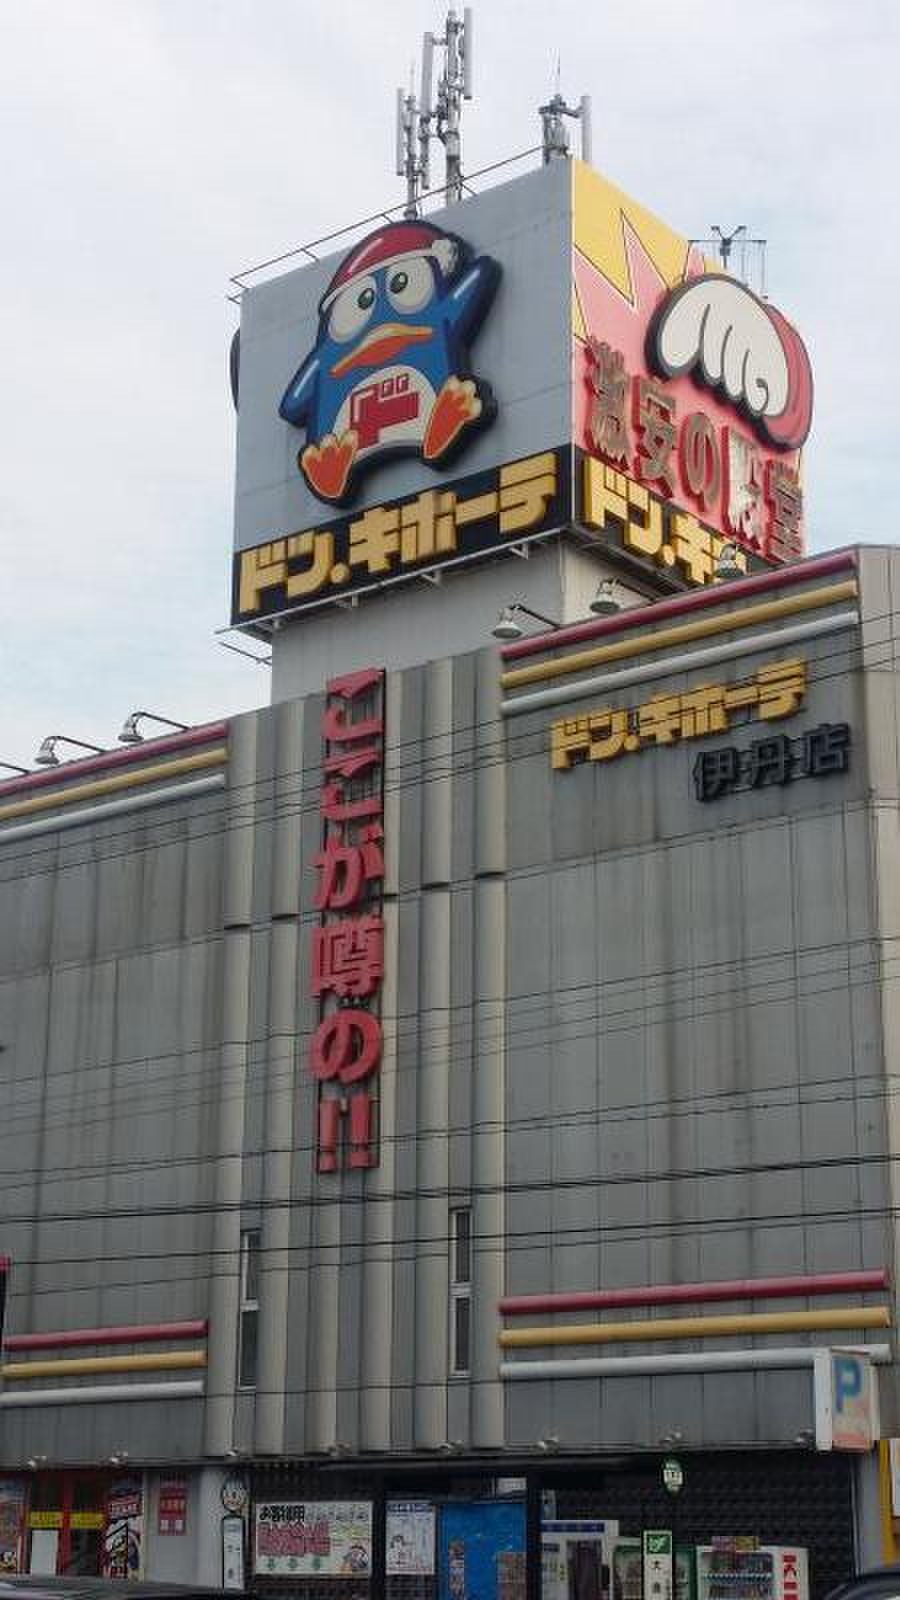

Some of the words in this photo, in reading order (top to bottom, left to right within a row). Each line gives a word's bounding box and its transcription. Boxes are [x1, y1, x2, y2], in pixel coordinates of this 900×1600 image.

[691, 722, 850, 802] 伊丹店
[834, 1356, 863, 1413] P
